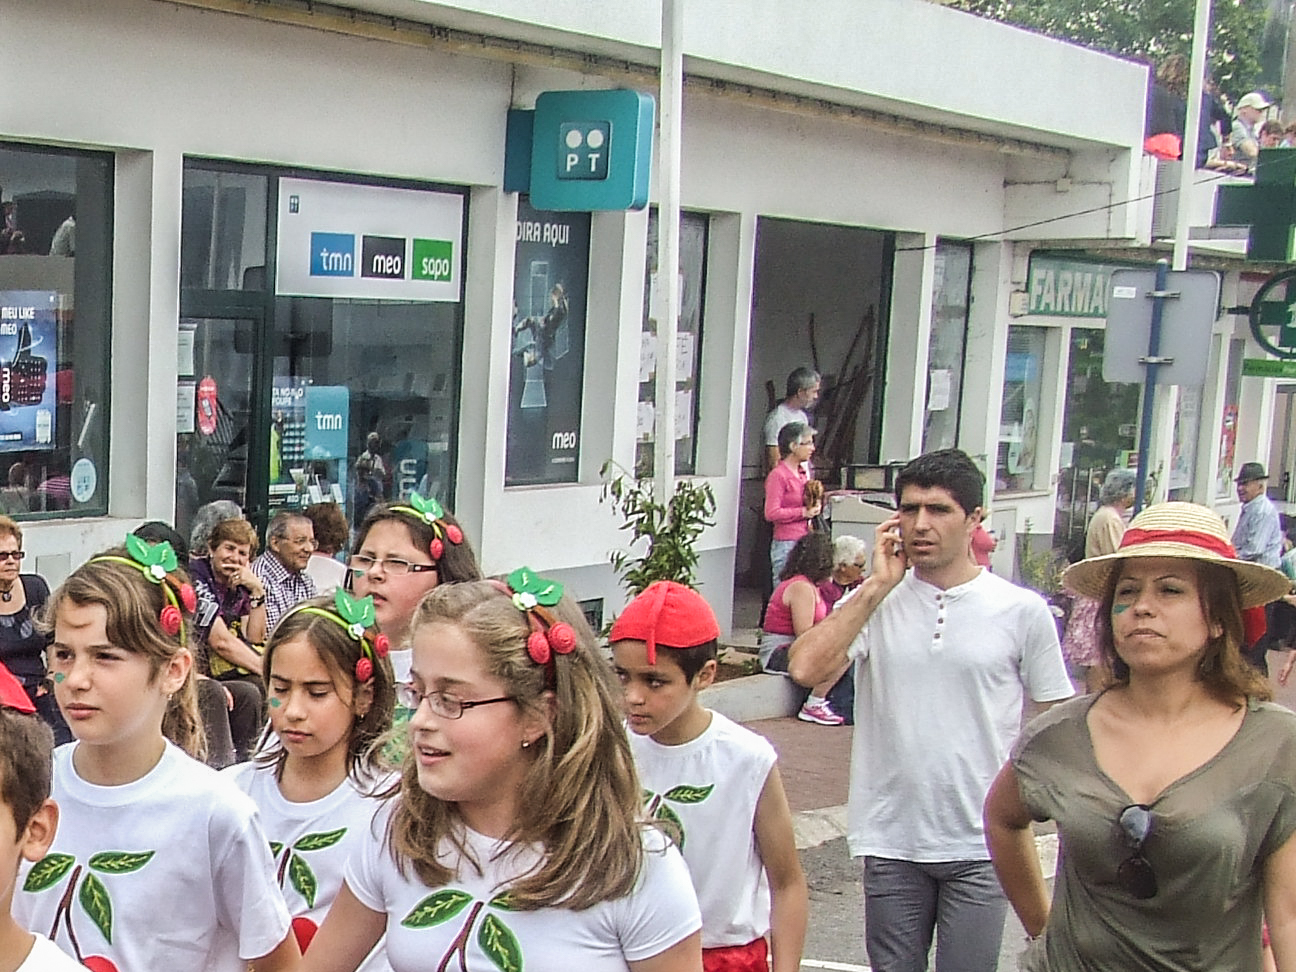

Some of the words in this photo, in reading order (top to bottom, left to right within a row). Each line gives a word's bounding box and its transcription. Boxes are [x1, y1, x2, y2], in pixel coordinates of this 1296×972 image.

[566, 153, 600, 172] PT
[543, 223, 570, 247] AQUI
[320, 248, 352, 271] tmn
[372, 254, 401, 274] meo
[421, 257, 449, 280] sapo
[1030, 264, 1111, 313] FARMÁ
[2, 307, 18, 319] MEU
[19, 306, 35, 319] LIKE
[0, 323, 17, 335] MEO
[2, 368, 11, 403] meo
[315, 411, 342, 430] tmn
[552, 432, 576, 449] meo
